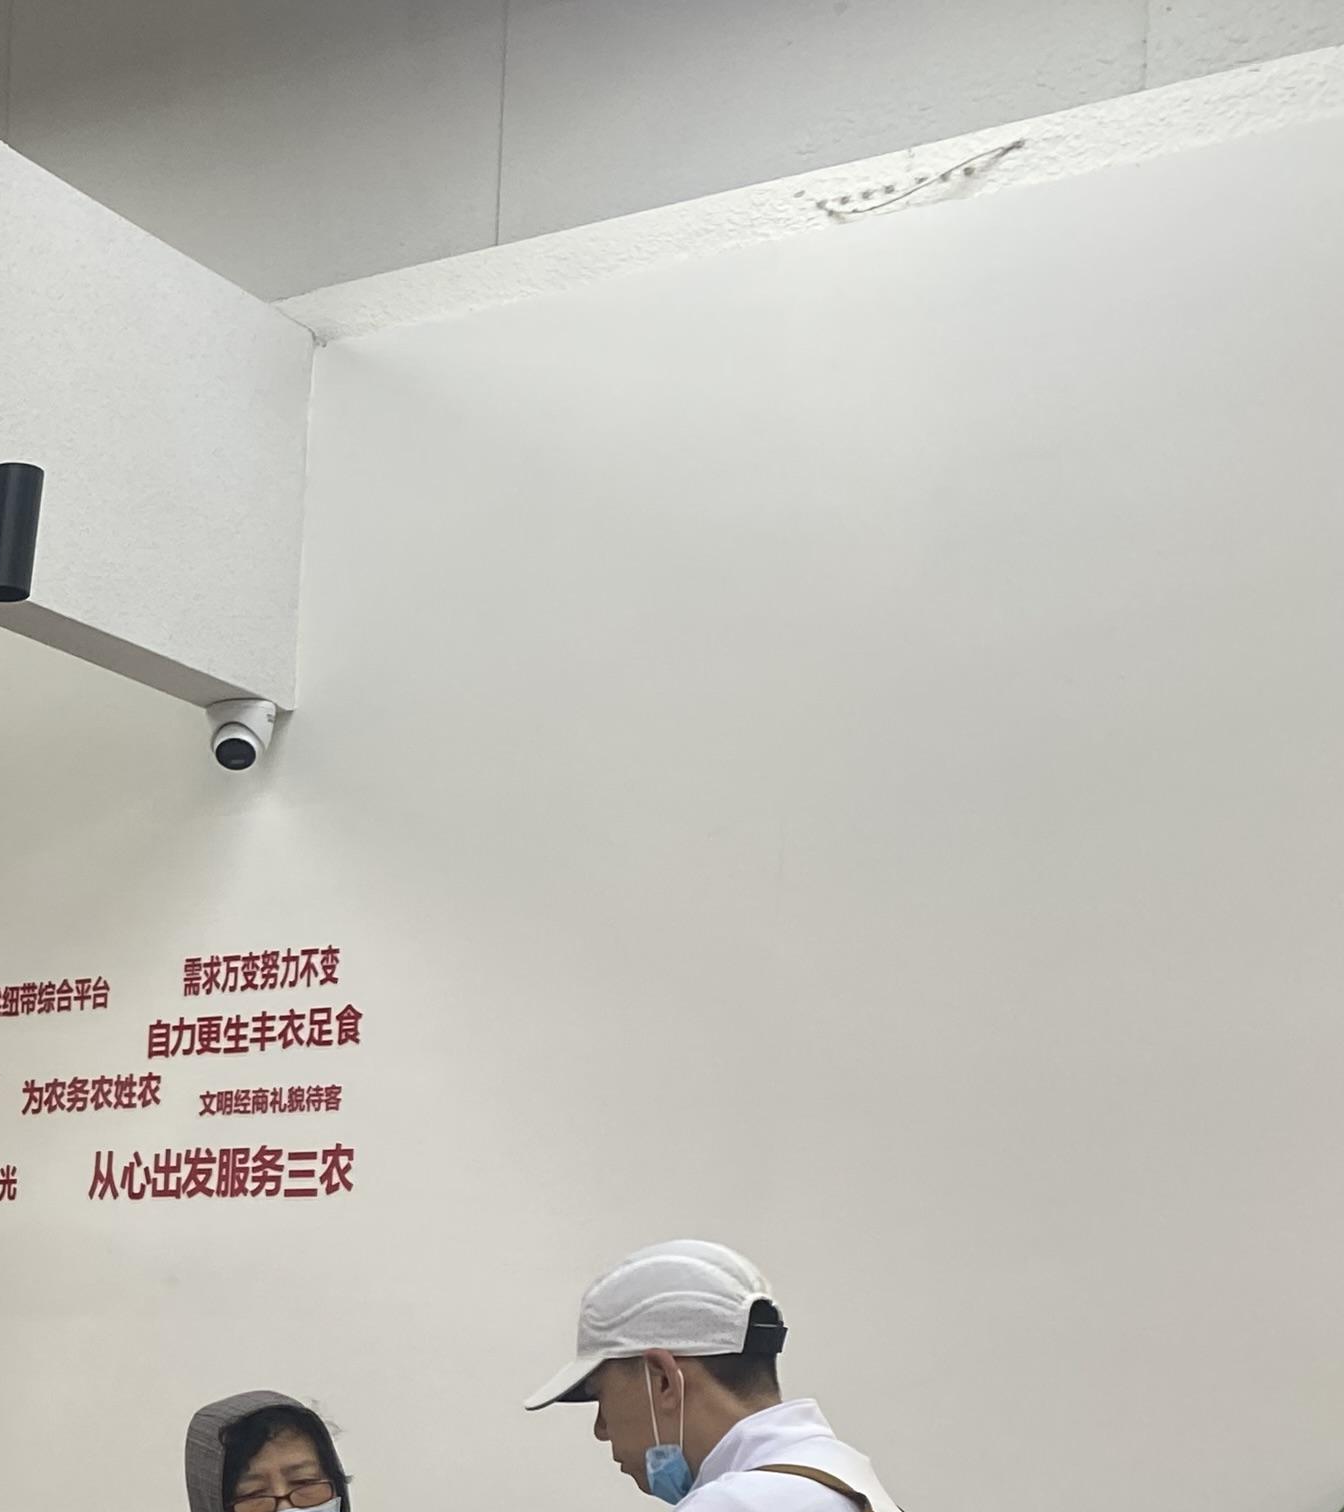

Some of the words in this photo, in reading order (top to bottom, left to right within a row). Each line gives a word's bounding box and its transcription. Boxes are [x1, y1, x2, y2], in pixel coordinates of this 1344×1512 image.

[183, 945, 340, 996] 需求万变努力不变
[147, 1003, 363, 1059] 自力更生丰衣足食
[22, 1072, 162, 1115] 为农务农姓农
[199, 1085, 342, 1116] 文明经商礼貌待客
[88, 1143, 354, 1201] 从心出发服务三农
